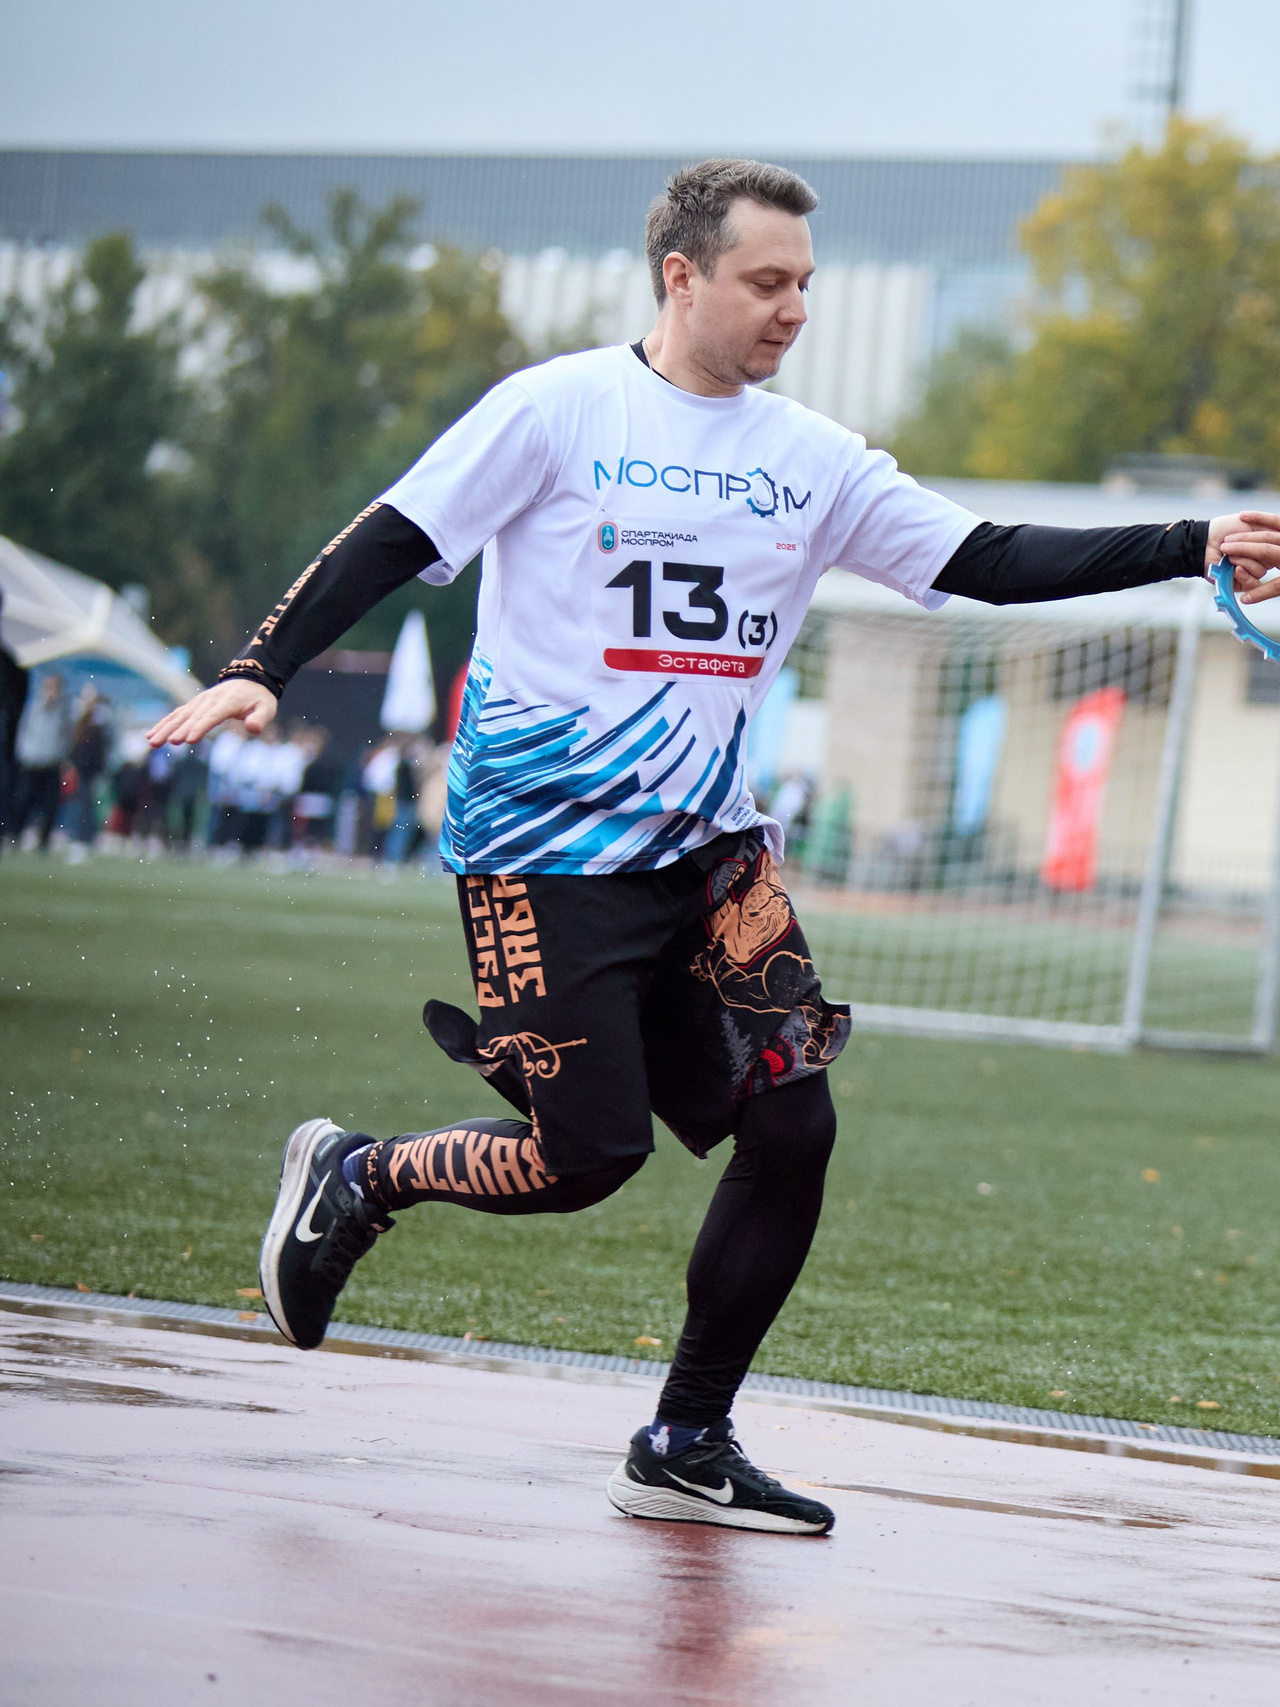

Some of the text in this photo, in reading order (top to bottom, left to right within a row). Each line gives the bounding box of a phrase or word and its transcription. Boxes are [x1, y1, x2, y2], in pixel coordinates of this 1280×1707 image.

[620, 529, 698, 543] СПАРТАКИАДА
[620, 537, 675, 548] МОСПРОМ
[775, 542, 798, 551] 2025
[604, 559, 779, 651] 13 (3)
[657, 653, 746, 675] Эстафета
[388, 1129, 560, 1196] РУССКАЯ
